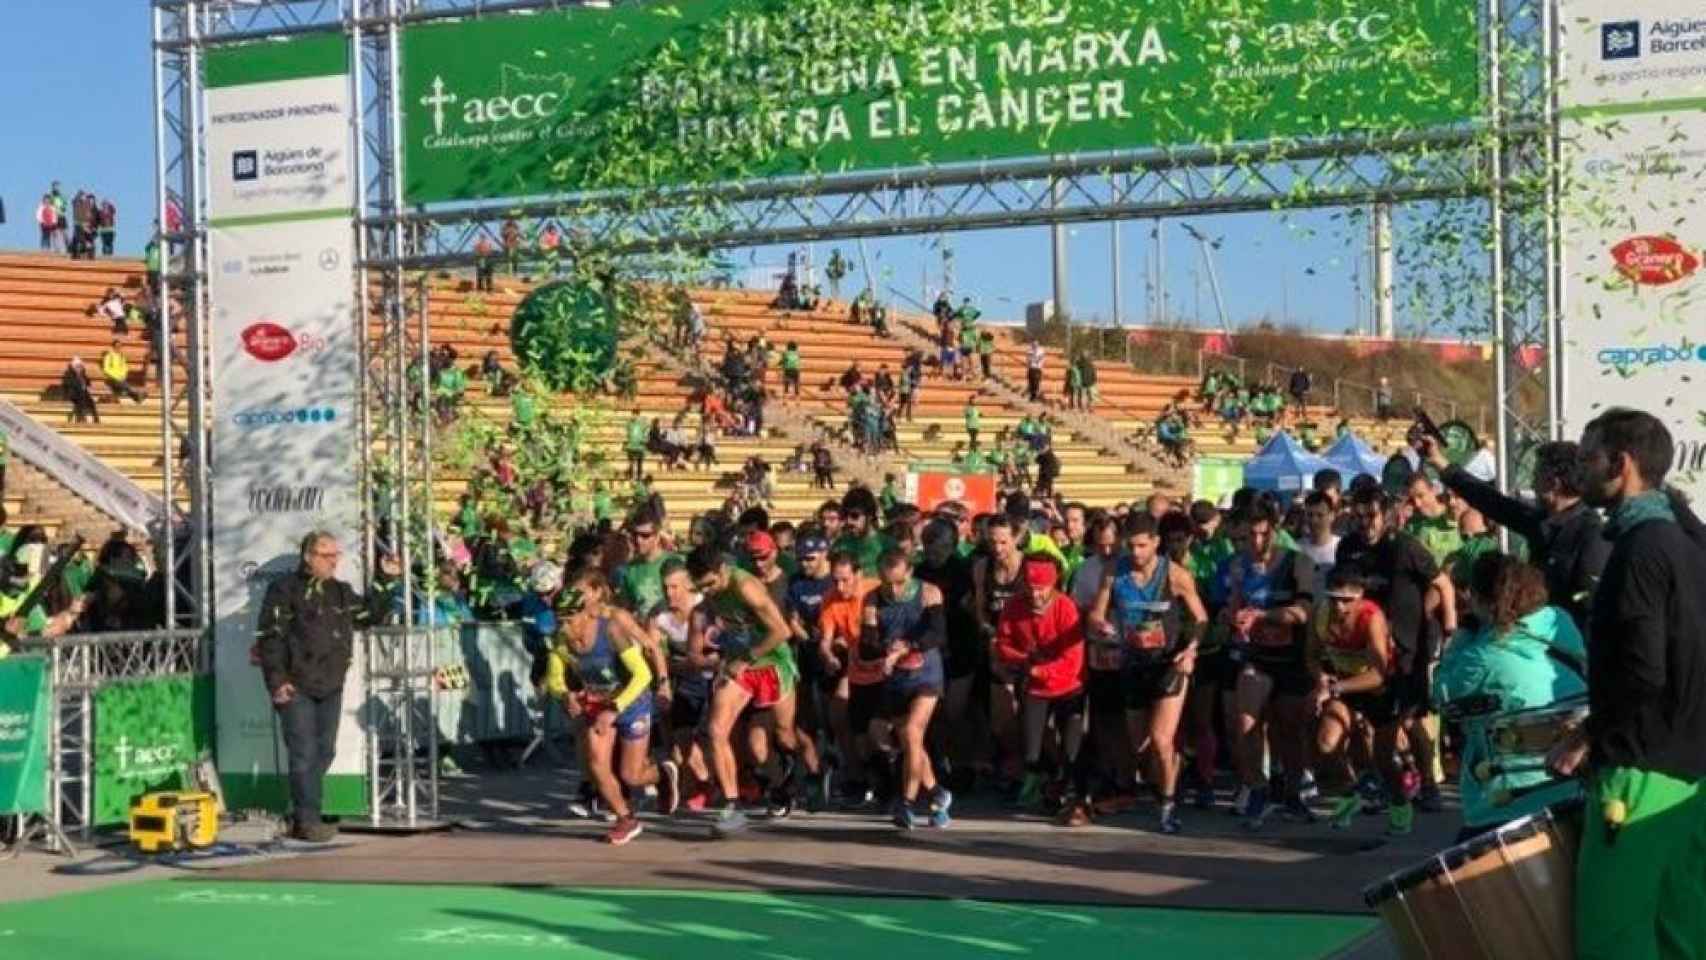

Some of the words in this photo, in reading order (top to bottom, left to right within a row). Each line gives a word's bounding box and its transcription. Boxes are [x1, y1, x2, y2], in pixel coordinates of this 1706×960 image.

[920, 44, 978, 87] EN
[998, 27, 1168, 80] MARXA
[464, 92, 559, 124] aecc
[868, 100, 922, 138] EL
[936, 79, 1132, 135] CÀNCER
[1598, 344, 1692, 367] caprabo
